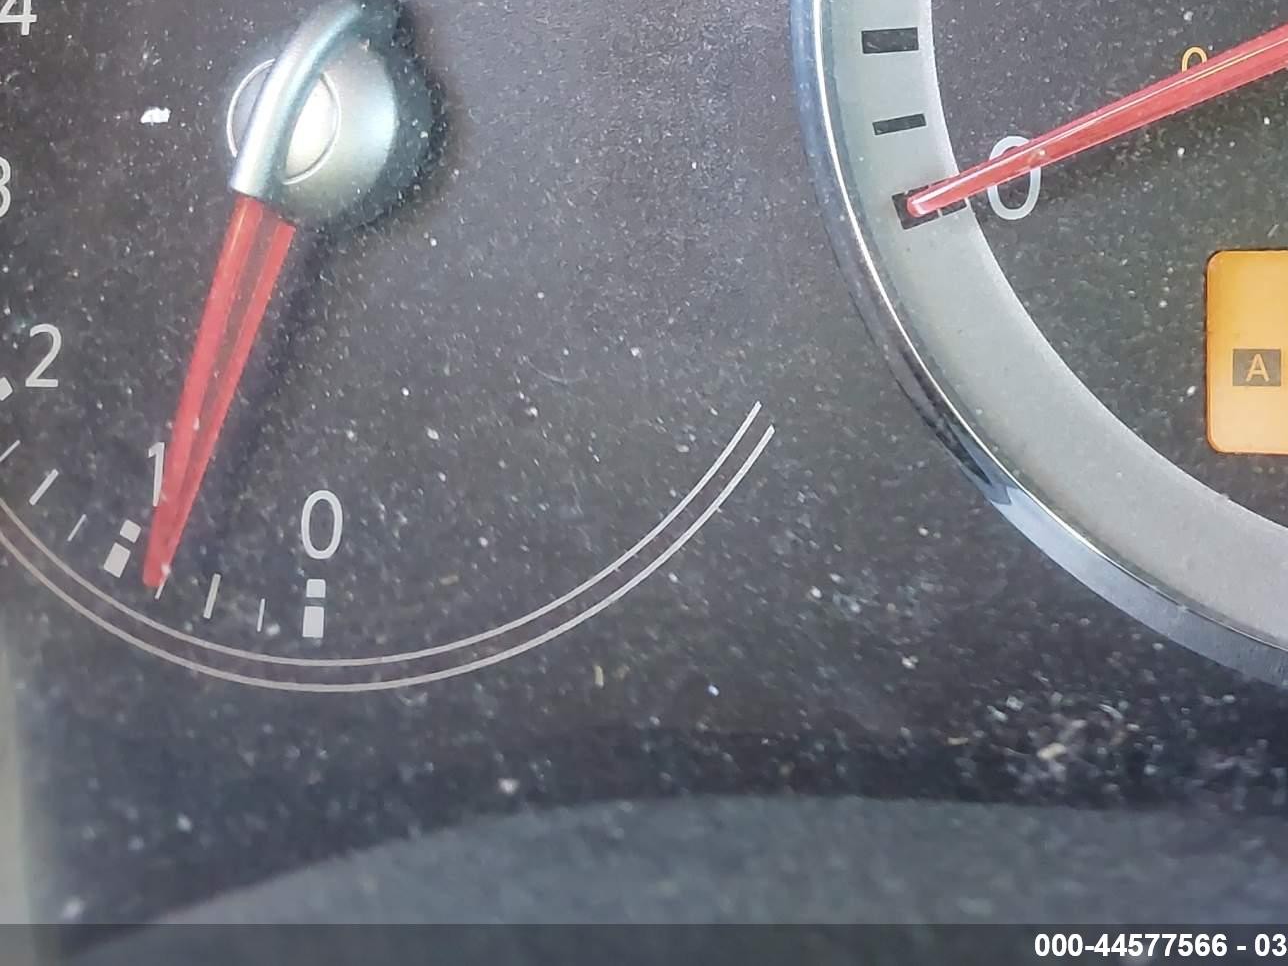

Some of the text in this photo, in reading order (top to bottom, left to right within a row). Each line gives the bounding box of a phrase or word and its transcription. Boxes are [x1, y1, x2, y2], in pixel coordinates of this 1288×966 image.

[986, 135, 1042, 221] 0
[24, 323, 63, 389] 2
[1245, 353, 1271, 382] A
[301, 489, 344, 560] 0
